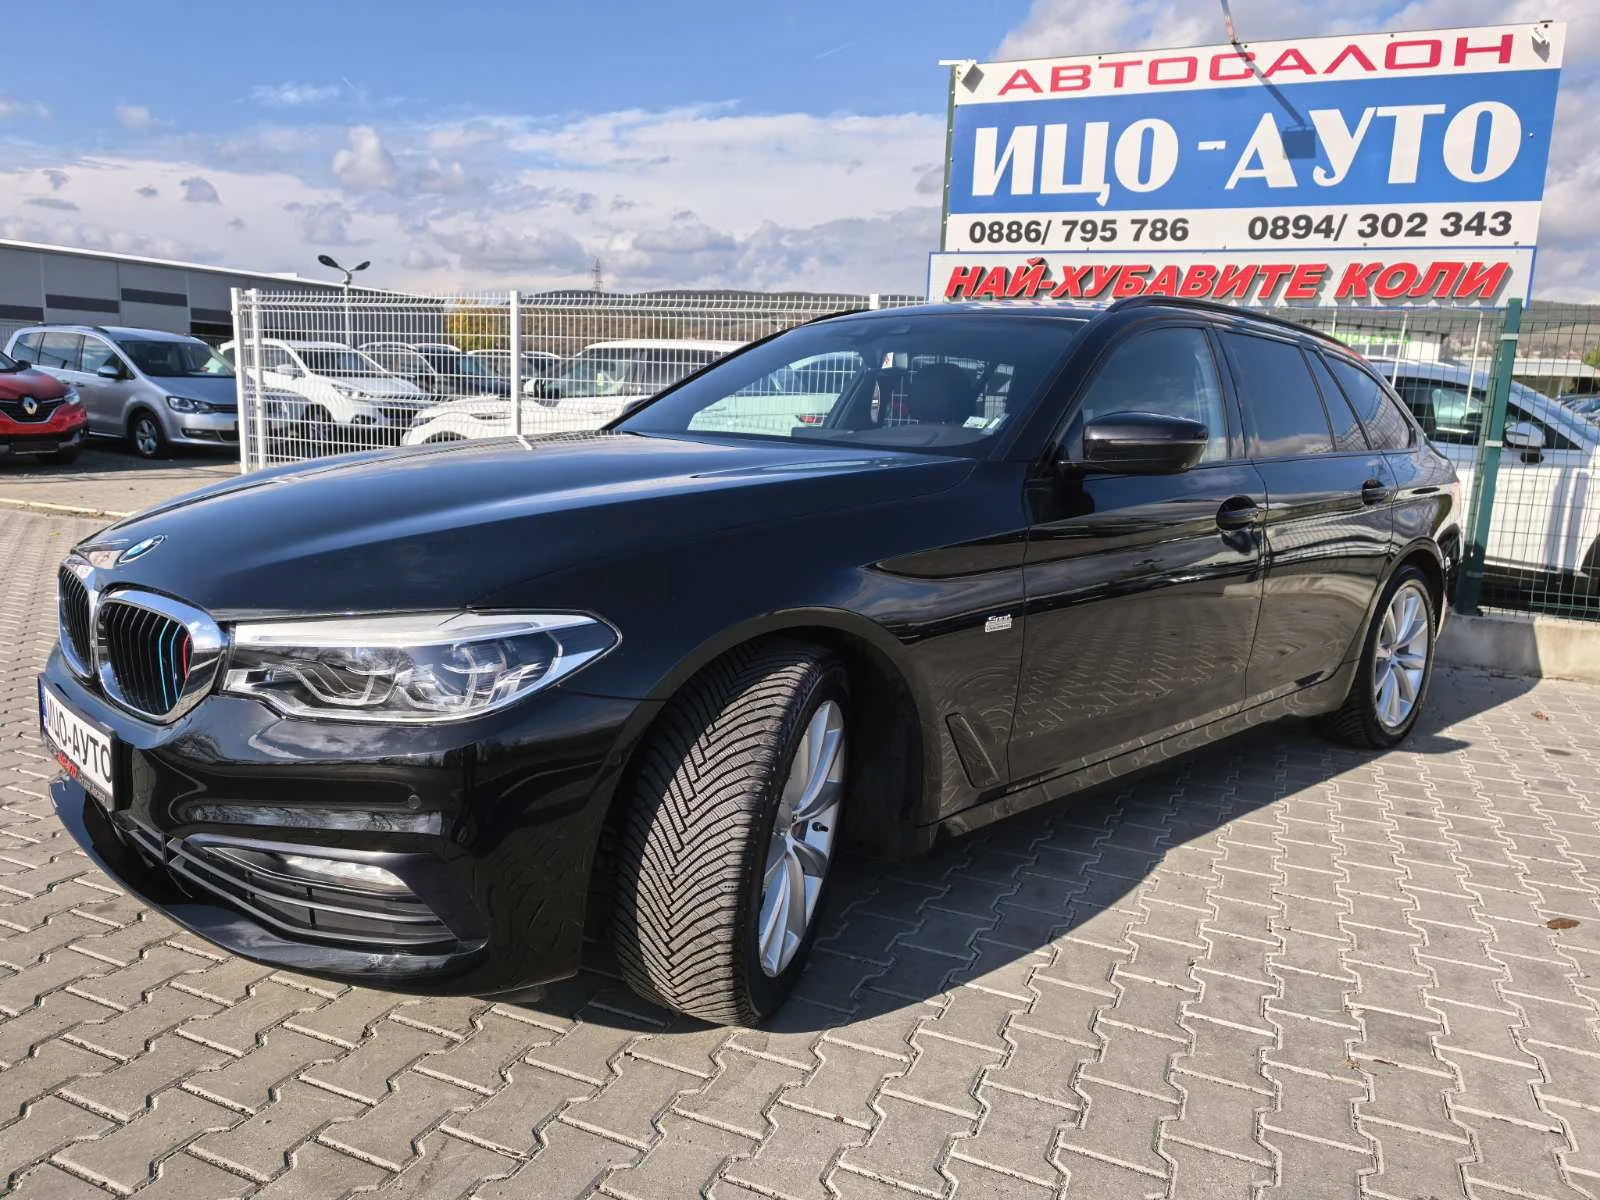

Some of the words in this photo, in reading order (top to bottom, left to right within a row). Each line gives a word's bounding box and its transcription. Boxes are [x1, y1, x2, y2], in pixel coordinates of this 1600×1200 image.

[997, 34, 1514, 96] АВТОСАЛОН
[968, 220, 1052, 246] 0886/
[1061, 218, 1118, 243] 795
[1129, 217, 1190, 242] 786
[1247, 213, 1348, 242] 0894/
[1357, 211, 1429, 239] 302
[1439, 210, 1513, 237] 343
[943, 256, 1328, 299] НАЙ-ХУБАВИТЕ
[1333, 261, 1511, 299] КОЛИ
